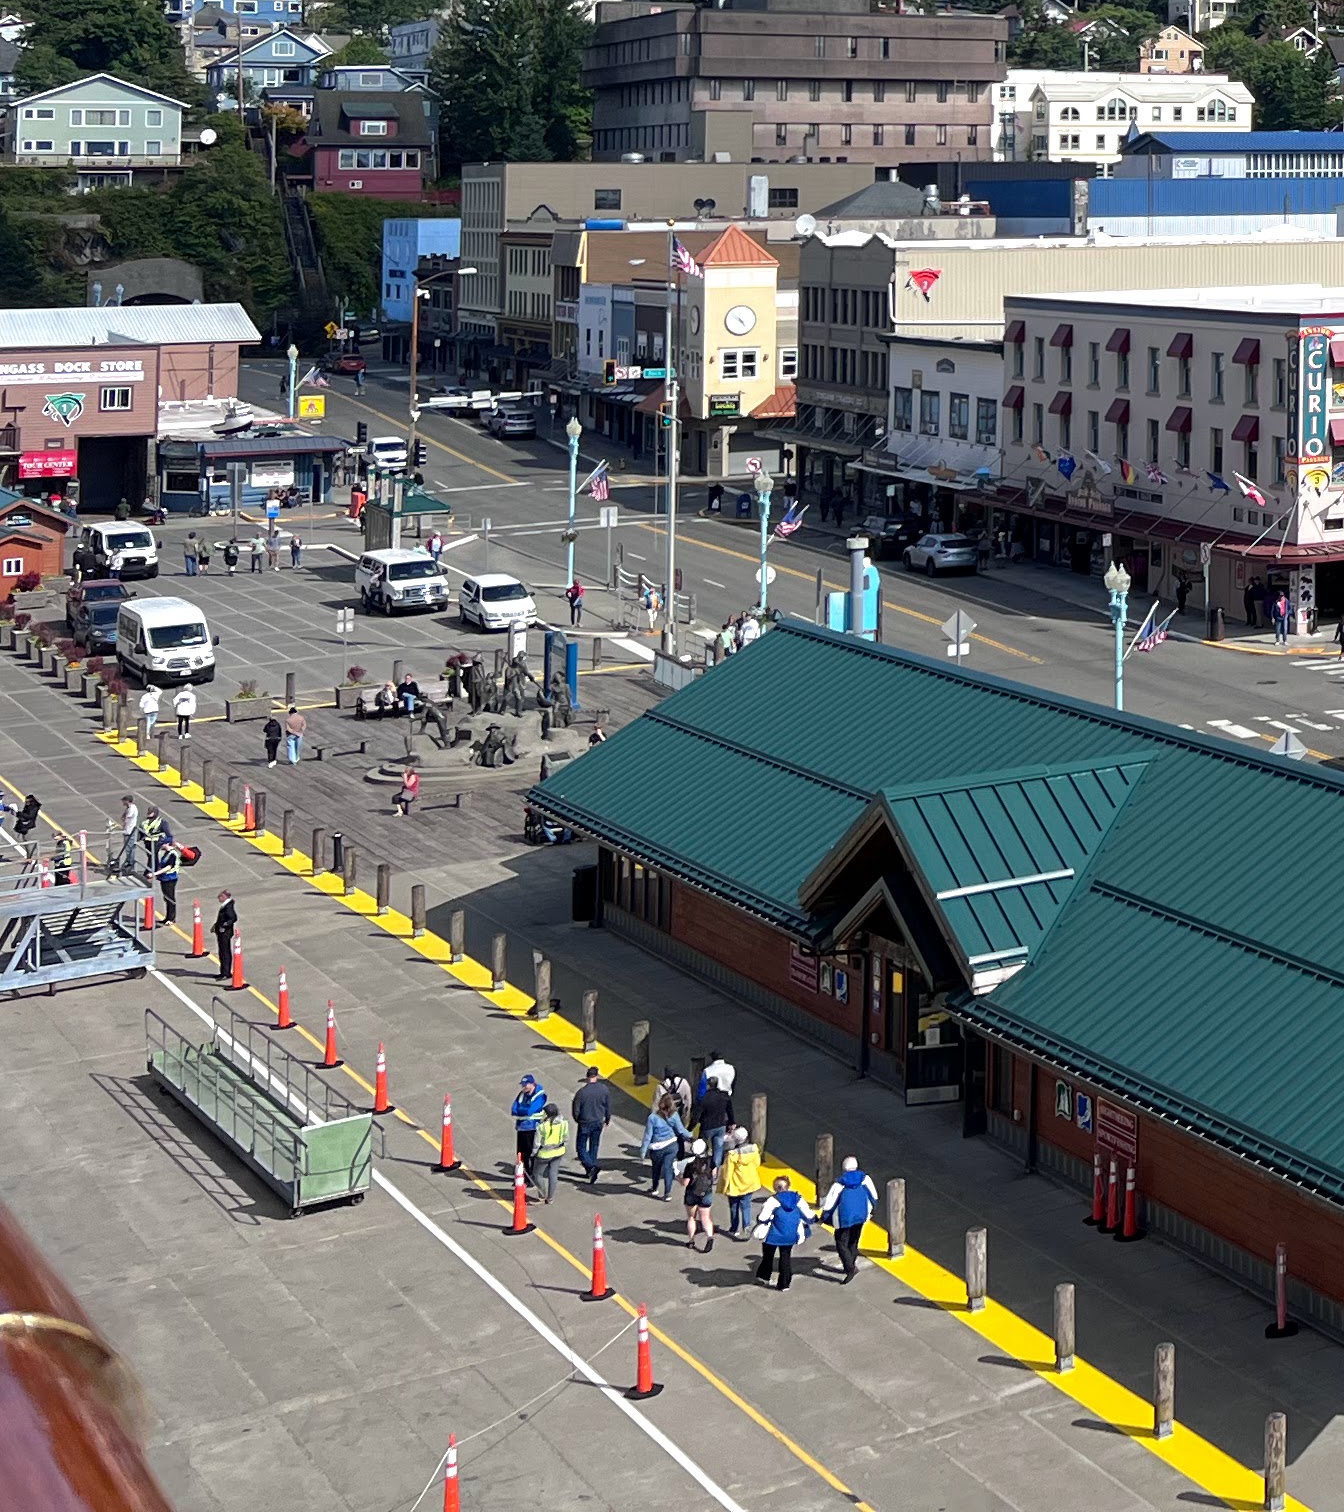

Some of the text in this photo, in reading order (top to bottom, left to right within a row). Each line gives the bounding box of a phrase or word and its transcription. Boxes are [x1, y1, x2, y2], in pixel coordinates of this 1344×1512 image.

[54, 362, 91, 373] DOCK
[100, 360, 143, 372] STORE
[1288, 350, 1298, 457] CURIO
[1305, 350, 1324, 457] CURIO
[44, 460, 73, 469] CENTER
